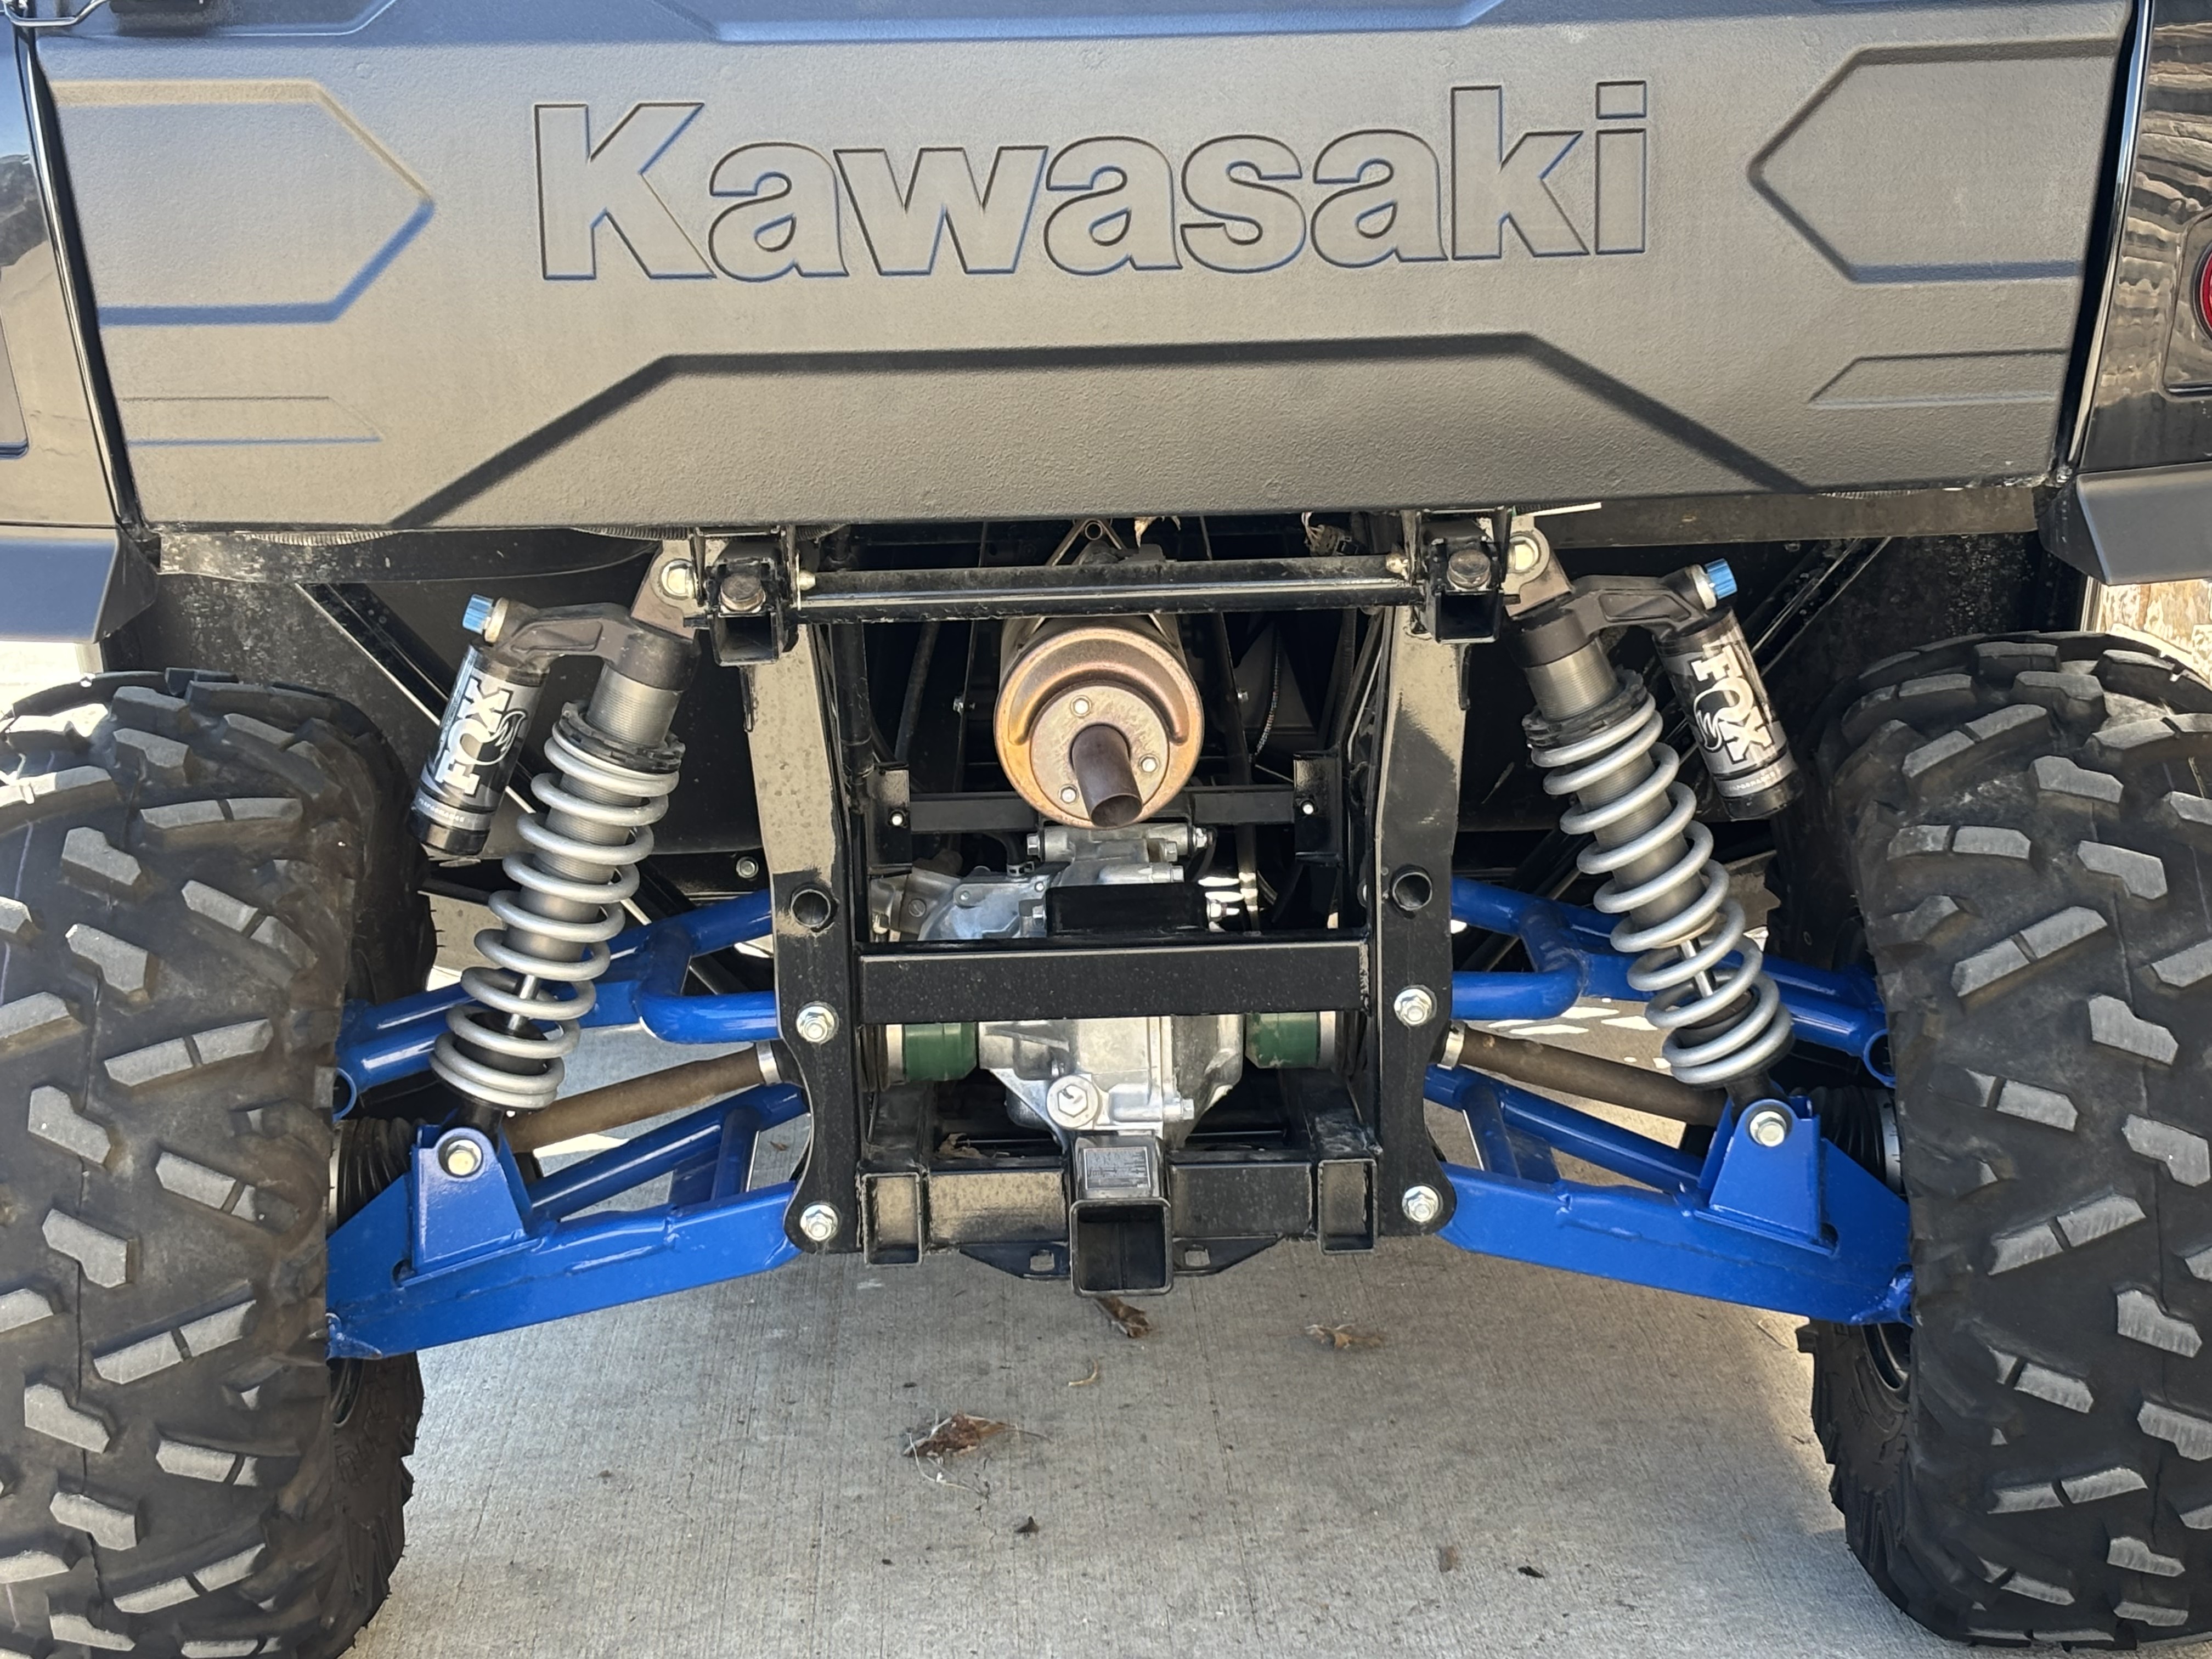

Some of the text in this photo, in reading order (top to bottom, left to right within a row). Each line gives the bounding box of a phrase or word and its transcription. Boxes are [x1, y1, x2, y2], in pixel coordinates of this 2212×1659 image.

[534, 80, 1647, 282] Kawasaki
[435, 678, 526, 795] FOX
[1691, 644, 1773, 762] FOX
